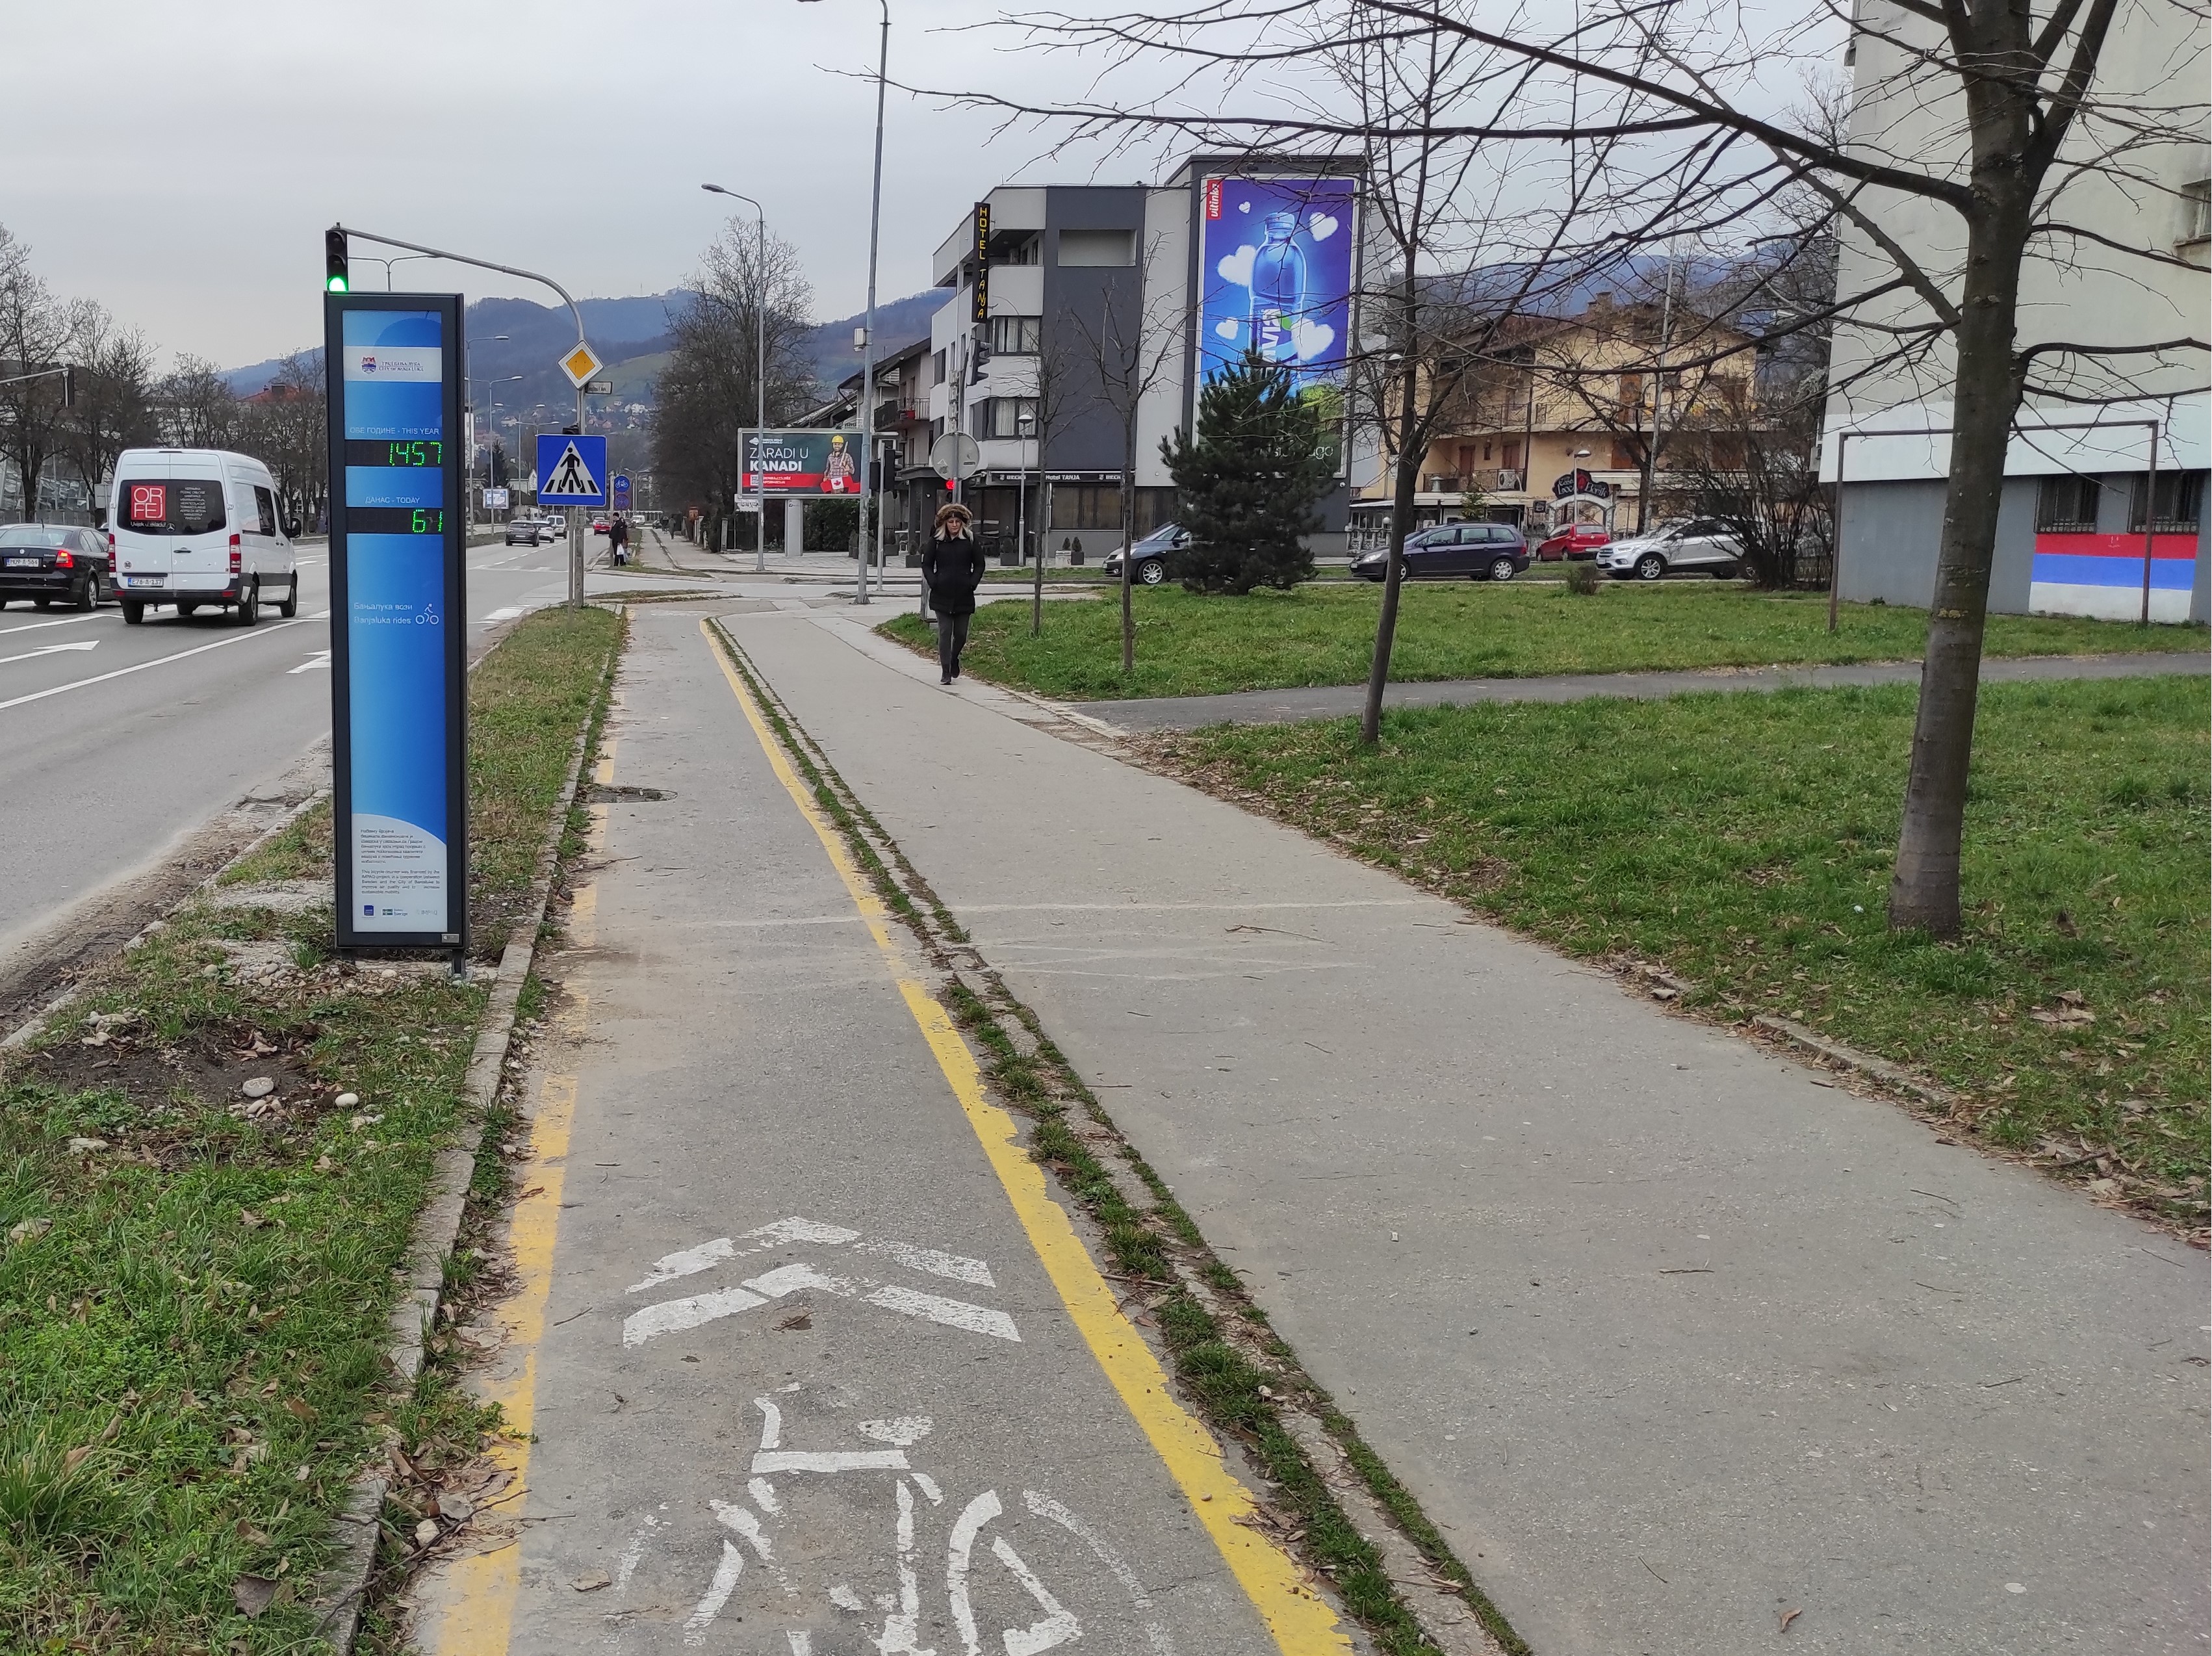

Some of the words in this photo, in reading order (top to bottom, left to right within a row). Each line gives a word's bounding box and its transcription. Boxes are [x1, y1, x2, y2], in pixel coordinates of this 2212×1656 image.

[979, 206, 988, 261] HOTEL
[977, 268, 986, 318] TANJA
[749, 447, 795, 459] ZARADI
[800, 447, 808, 459] U
[750, 460, 802, 472] KANADI
[412, 509, 443, 533] 61
[354, 602, 393, 612] Бањалука
